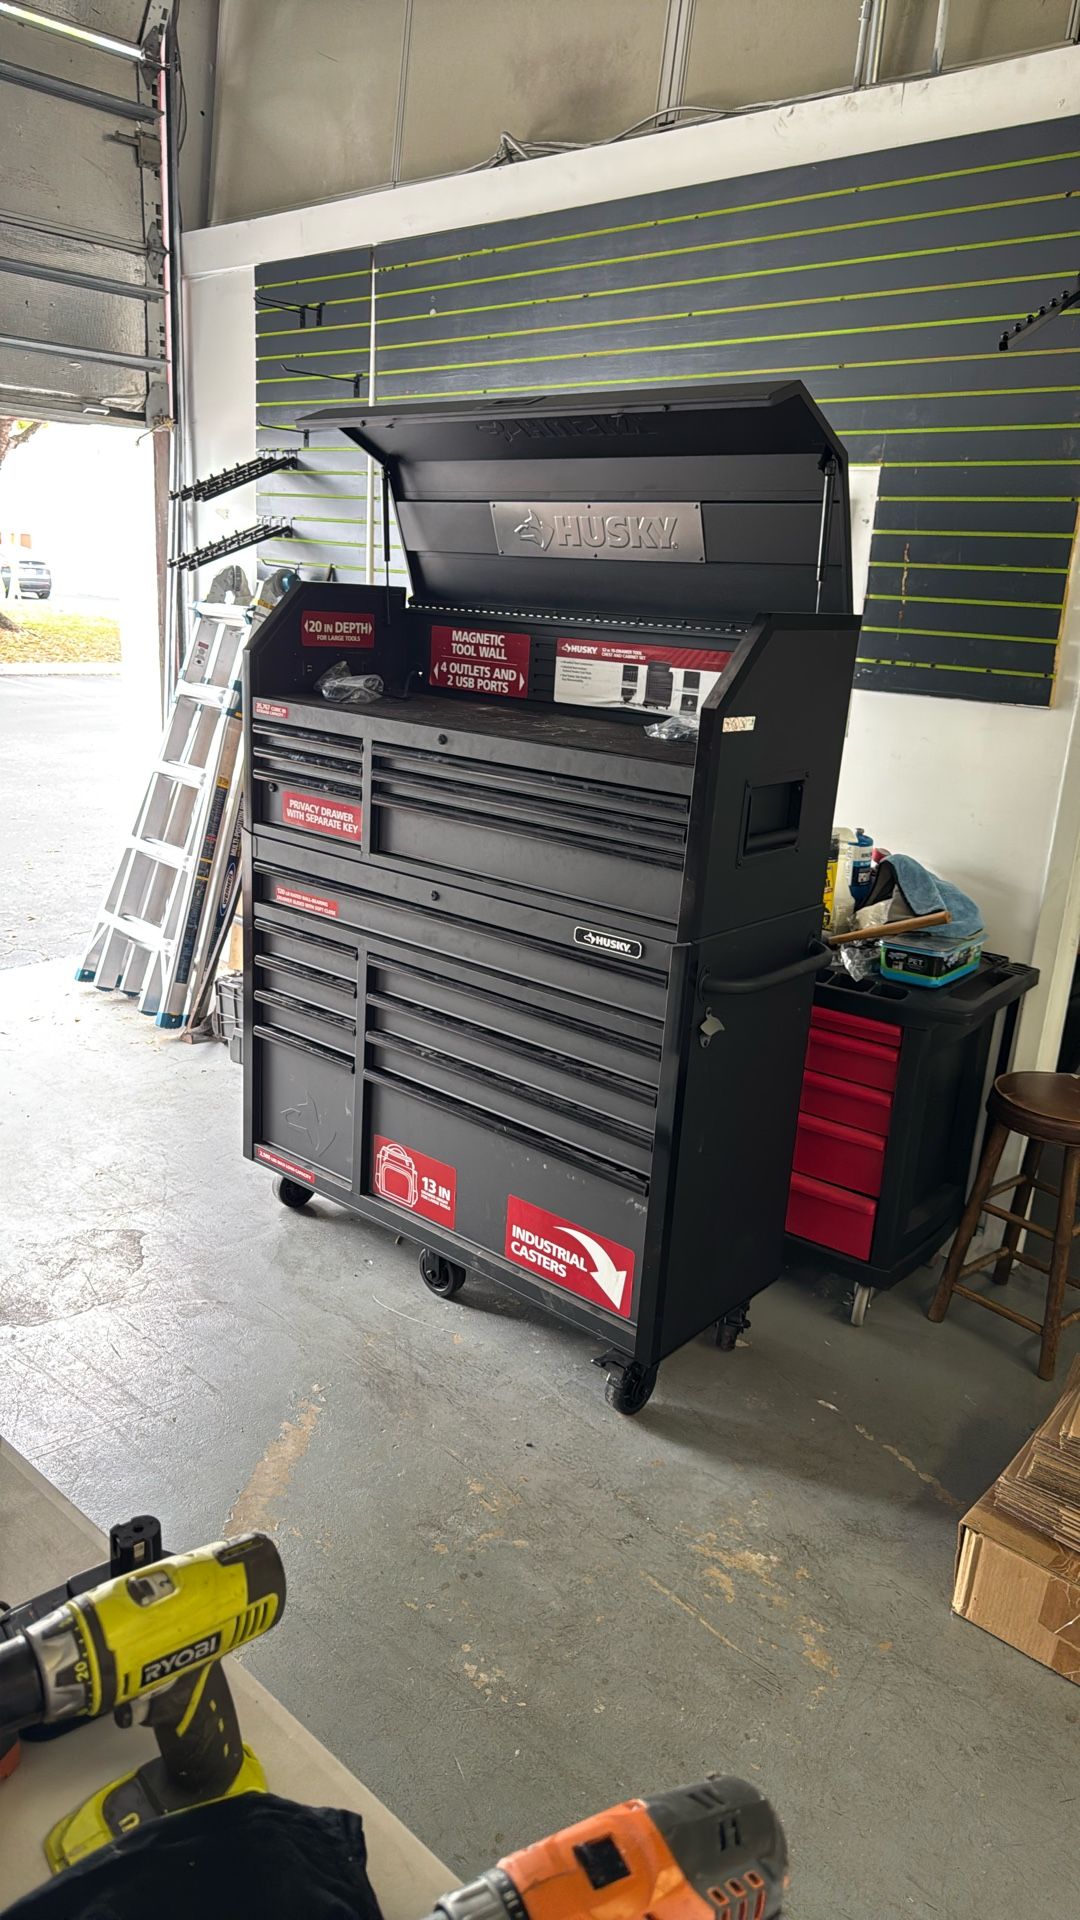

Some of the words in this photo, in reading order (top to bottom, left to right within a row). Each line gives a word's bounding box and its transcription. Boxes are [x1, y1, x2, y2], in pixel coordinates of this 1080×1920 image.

[554, 515, 678, 549] HUSKY
[309, 620, 322, 633] 20
[324, 623, 333, 633] IN
[335, 621, 368, 634] DEPTH
[452, 630, 505, 647] MAGNETIC
[451, 643, 477, 657] TOOL
[479, 646, 508, 660] WALL
[570, 644, 598, 655] HUSKY
[440, 662, 447, 673] 4
[449, 662, 491, 679] OUTLETS
[492, 667, 517, 681] AND
[447, 675, 454, 686] 2
[455, 676, 475, 689] USB
[477, 678, 509, 694] PORTS
[286, 808, 305, 820] WITH
[305, 813, 342, 830] SEPARATE
[342, 822, 359, 834] KEY
[289, 799, 320, 814] PRIVACY
[320, 807, 354, 823] DRAWER
[595, 935, 631, 953] HUSKY
[422, 1176, 436, 1194] 13
[438, 1185, 450, 1201] IN
[512, 1224, 588, 1272] INDUSTRIAL
[511, 1241, 567, 1277] CASTERS
[144, 1637, 217, 1682] RYOBI
[74, 1661, 90, 1682] 20
